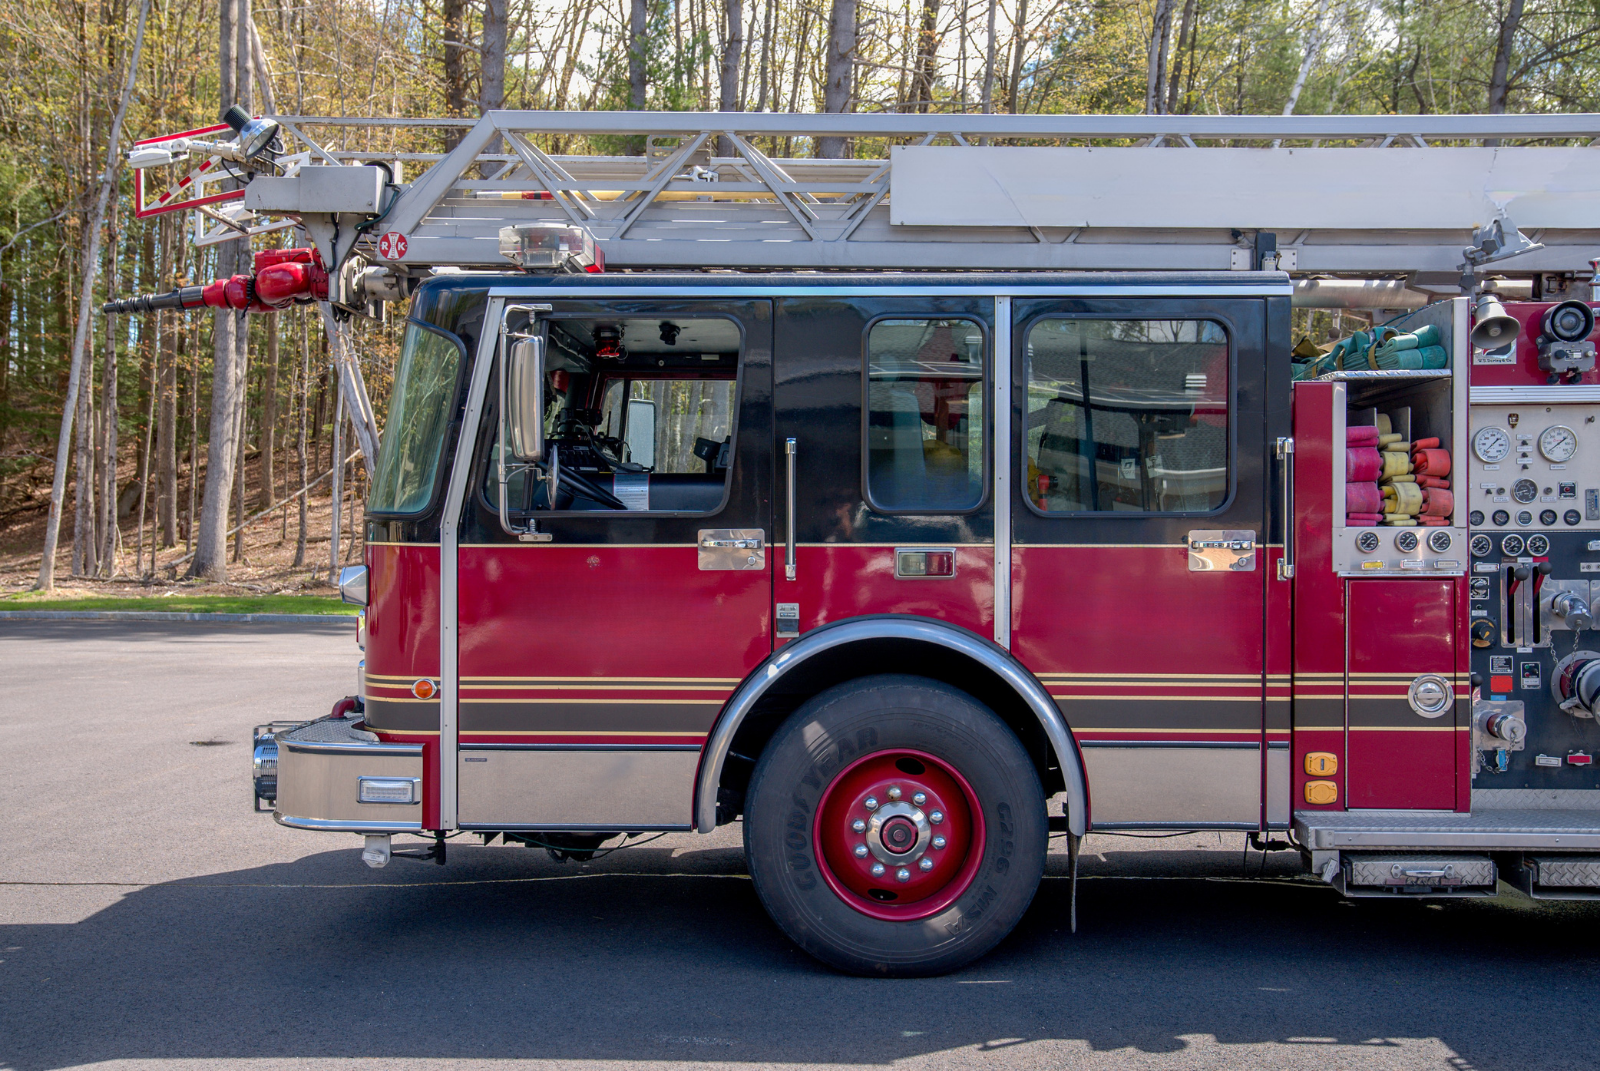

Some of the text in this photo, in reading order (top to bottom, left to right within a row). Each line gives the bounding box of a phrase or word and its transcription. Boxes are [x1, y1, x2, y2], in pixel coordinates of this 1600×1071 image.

[381, 241, 405, 250] R K
[786, 727, 878, 890] GOODYEAR
[943, 801, 1014, 936] G296 MSA
